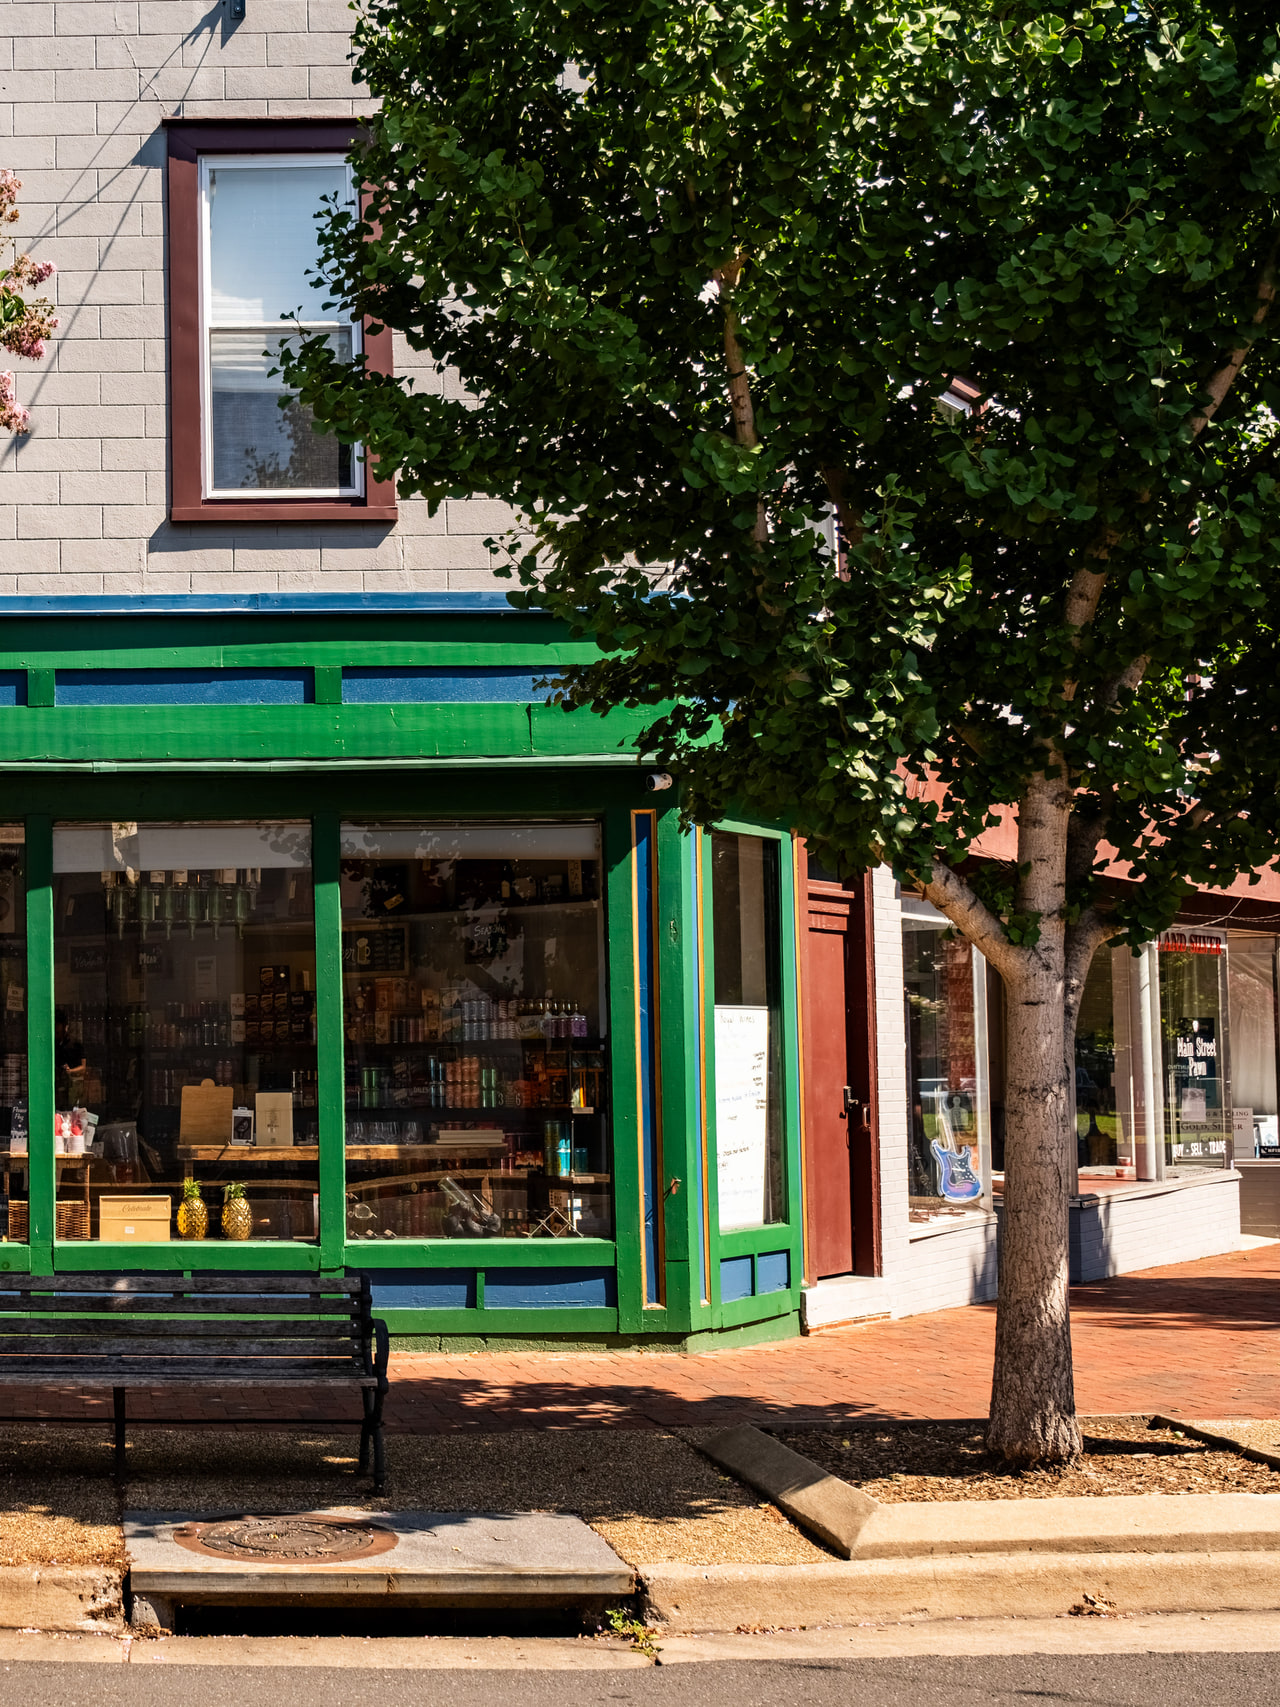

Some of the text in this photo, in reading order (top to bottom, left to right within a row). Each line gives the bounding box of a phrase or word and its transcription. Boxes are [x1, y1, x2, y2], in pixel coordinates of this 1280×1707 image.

[1163, 932, 1187, 953] AND
[1189, 934, 1222, 955] SILVER
[1177, 1036, 1217, 1057] Main Street
[1188, 1057, 1207, 1077] Pawn
[1211, 1121, 1243, 1131] SIER
[1173, 1140, 1226, 1158] BUY SELL TRADE
